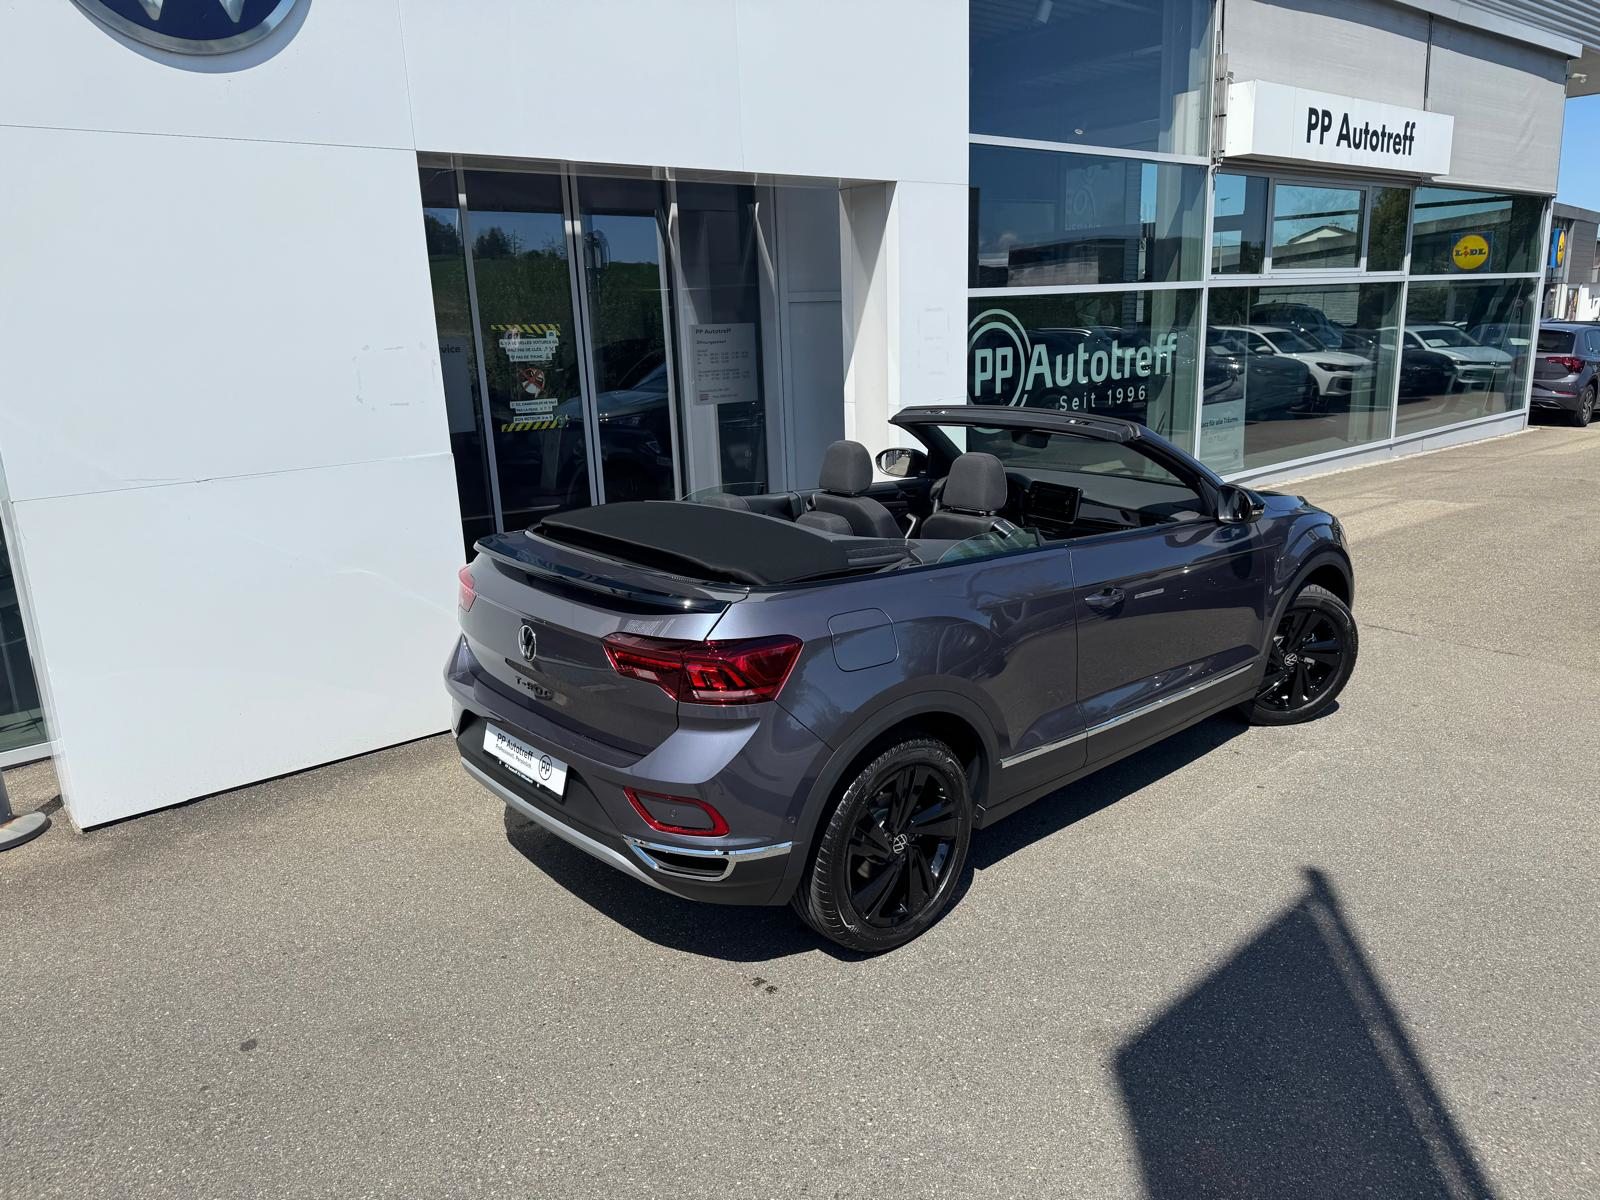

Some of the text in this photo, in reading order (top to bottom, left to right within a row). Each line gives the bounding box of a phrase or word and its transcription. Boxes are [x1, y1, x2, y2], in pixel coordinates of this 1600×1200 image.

[1306, 107, 1416, 156] PP Autotreff
[974, 332, 1178, 397] PP Autotreff
[1059, 385, 1146, 411] Seit 1996
[496, 732, 533, 760] PP Autotreff
[540, 759, 551, 775] PP
